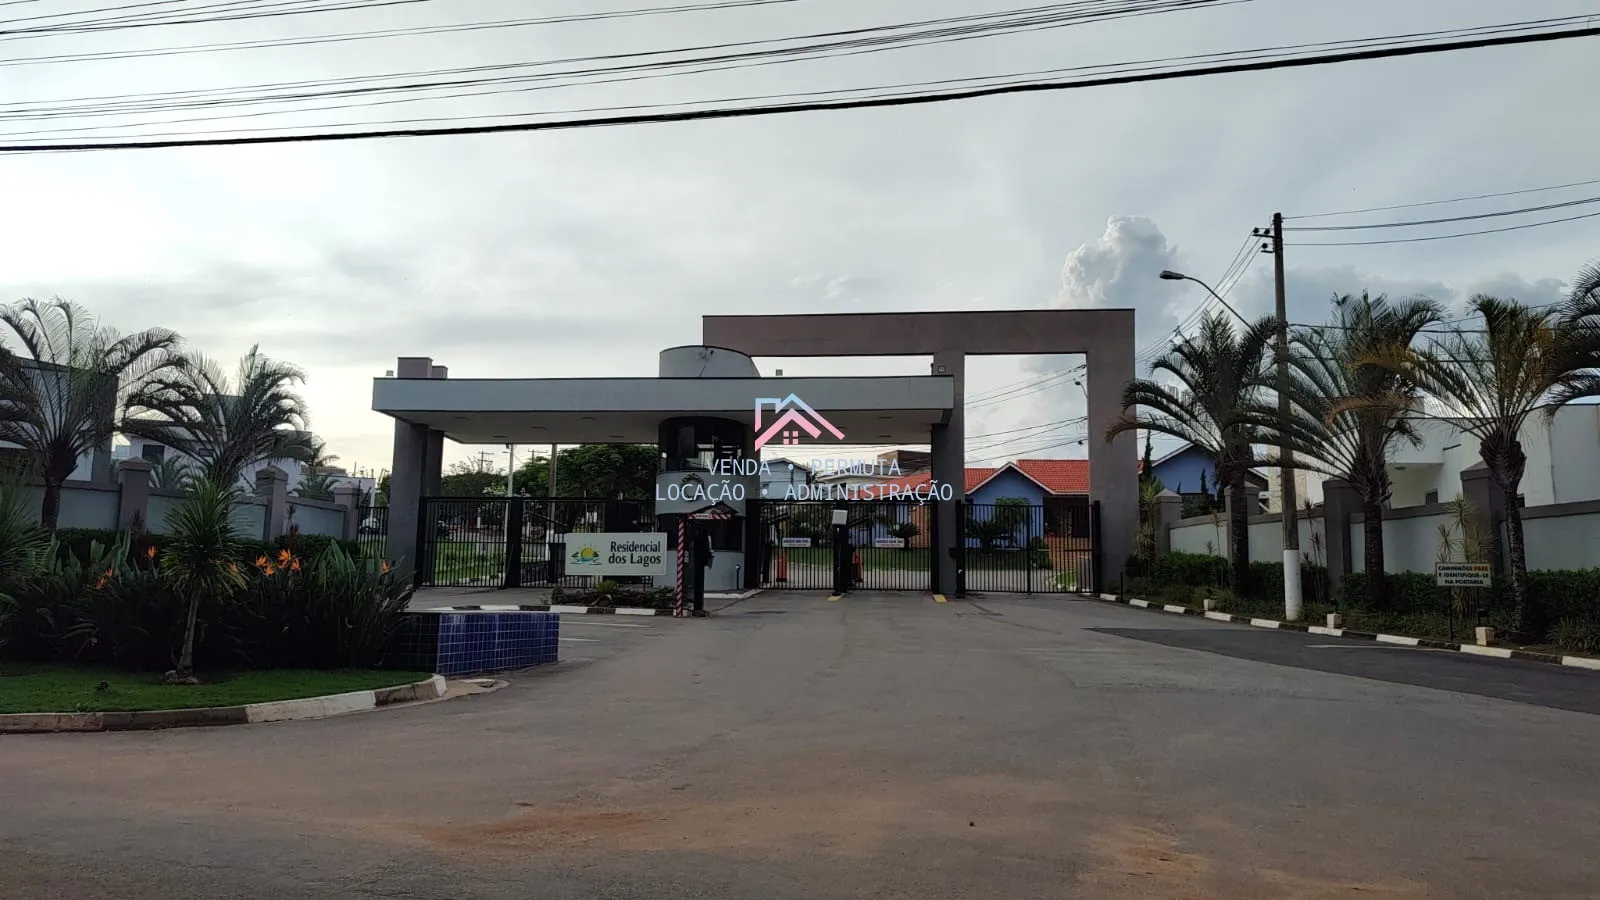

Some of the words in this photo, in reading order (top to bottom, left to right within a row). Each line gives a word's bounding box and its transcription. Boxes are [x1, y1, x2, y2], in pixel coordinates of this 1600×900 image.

[610, 540, 661, 553] Residencial
[608, 553, 627, 565] dos
[630, 553, 662, 568] Lagos
